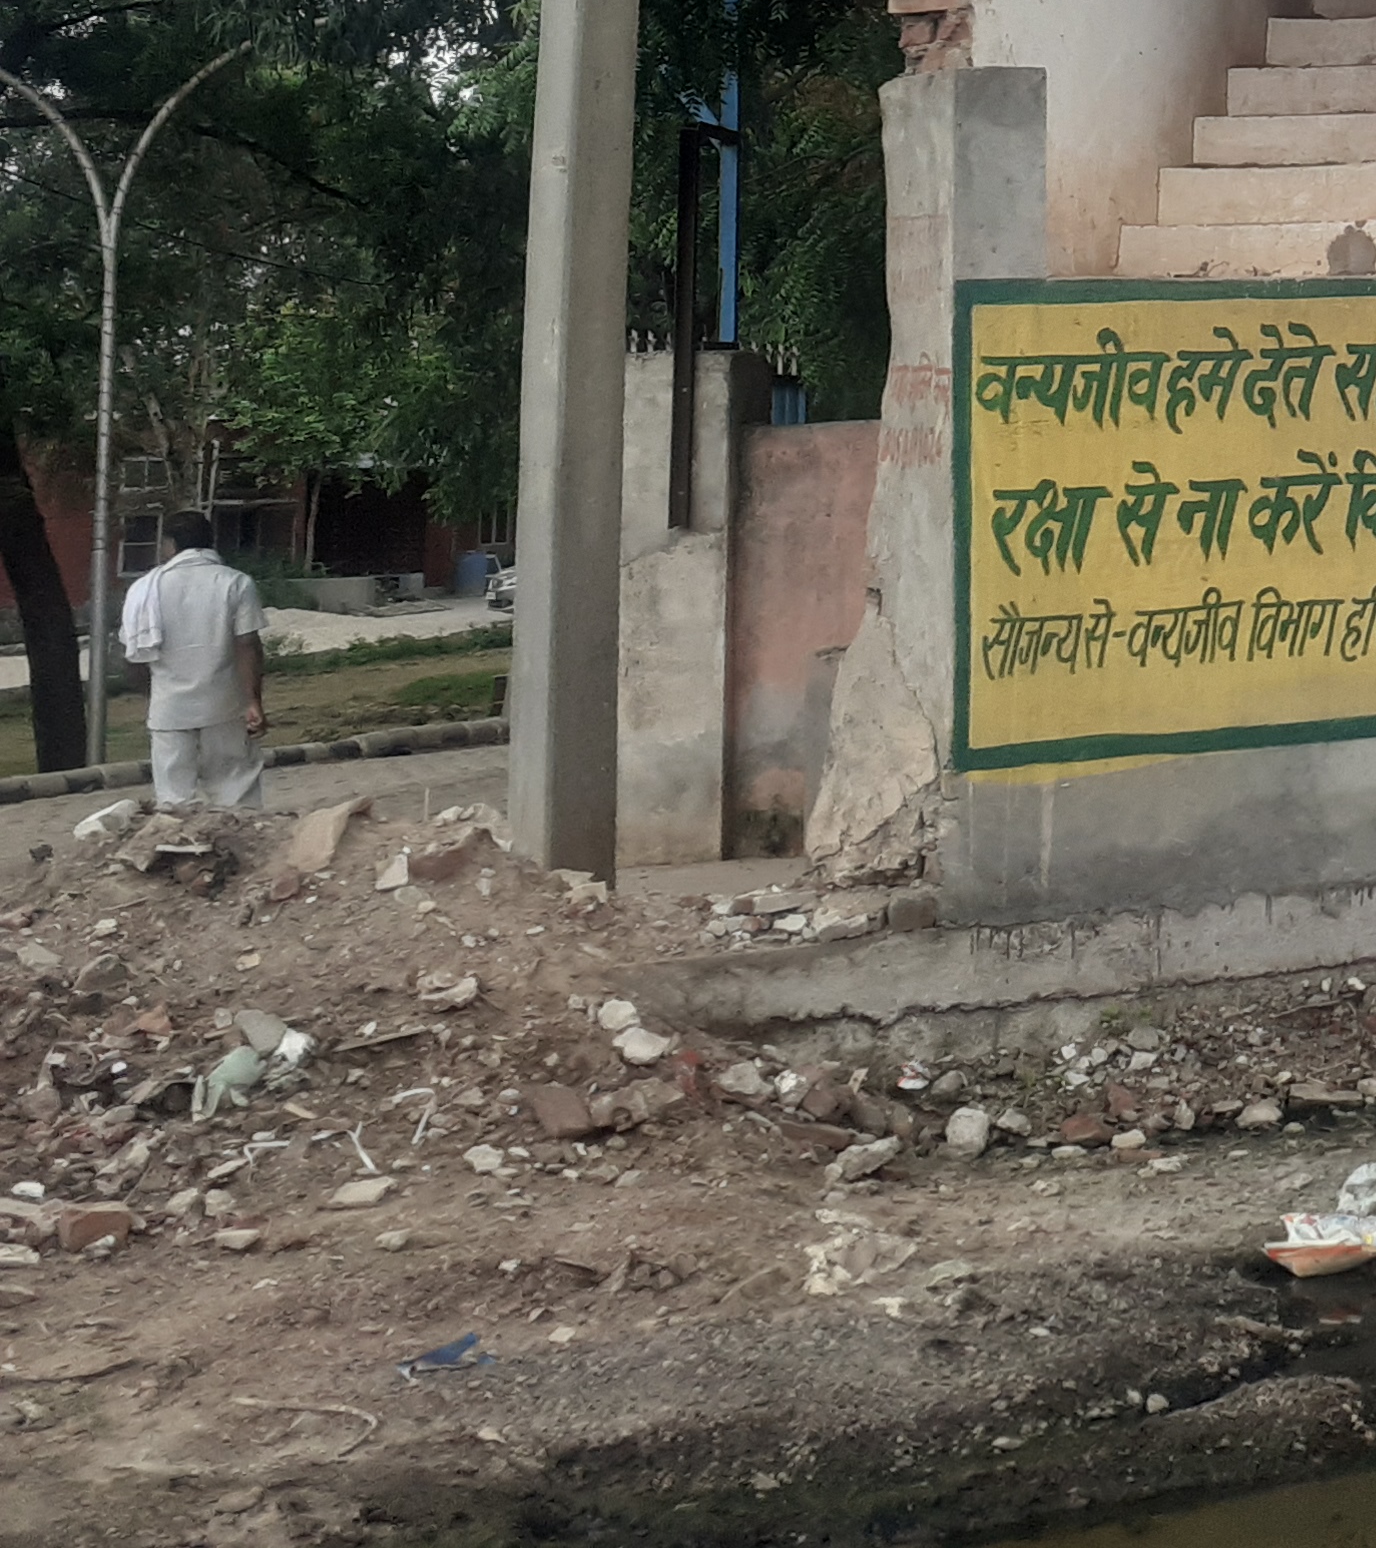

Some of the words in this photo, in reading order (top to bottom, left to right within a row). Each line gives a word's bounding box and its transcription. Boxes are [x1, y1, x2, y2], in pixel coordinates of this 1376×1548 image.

[975, 327, 1171, 431] वन्यजीव
[1243, 321, 1336, 429] देते
[991, 479, 1112, 576] रक्षा
[1116, 460, 1181, 567] से
[1177, 477, 1248, 562] ना
[1248, 449, 1345, 556] करें
[1246, 585, 1345, 664] विभाग
